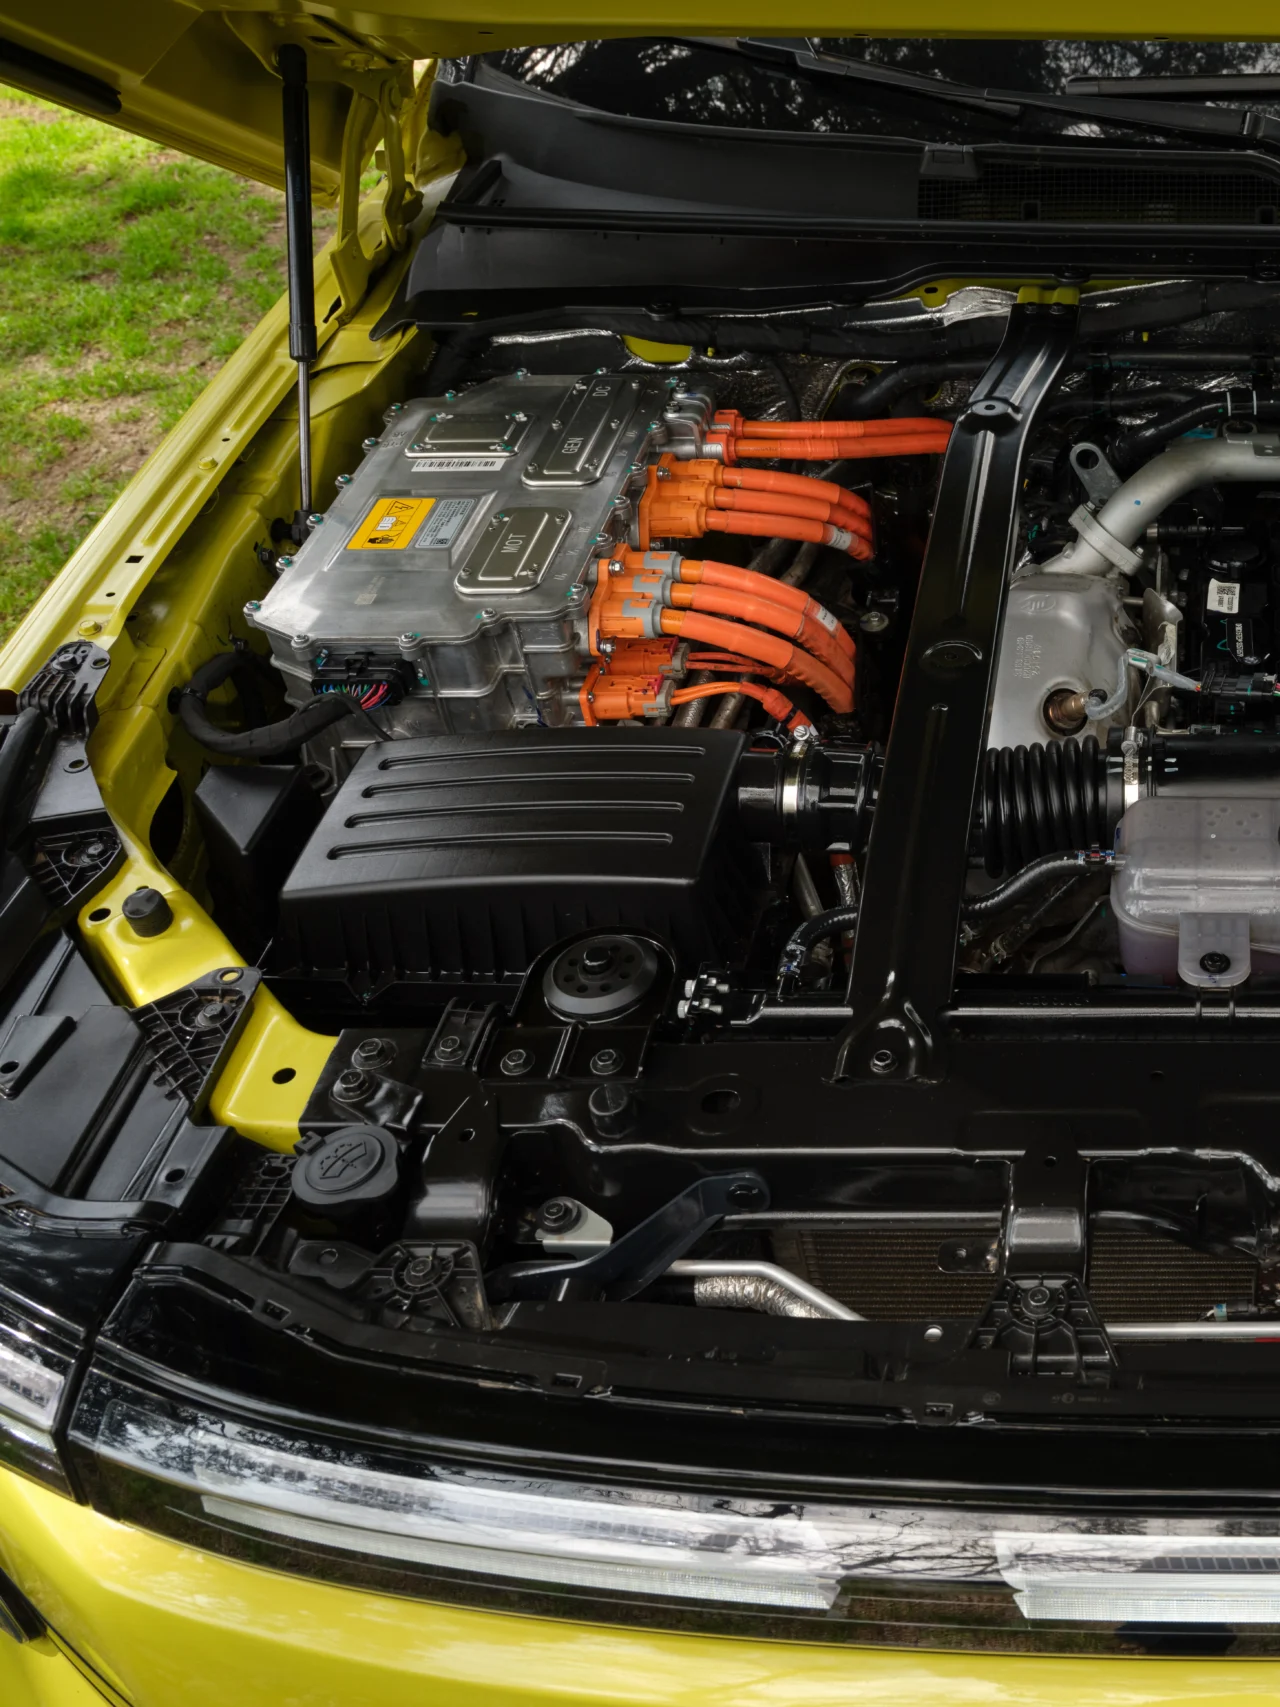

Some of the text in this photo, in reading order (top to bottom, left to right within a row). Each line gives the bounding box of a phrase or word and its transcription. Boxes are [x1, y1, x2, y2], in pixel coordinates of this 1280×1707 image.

[592, 385, 611, 397] DC
[561, 437, 585, 454] GEN
[500, 532, 527, 553] MOT
